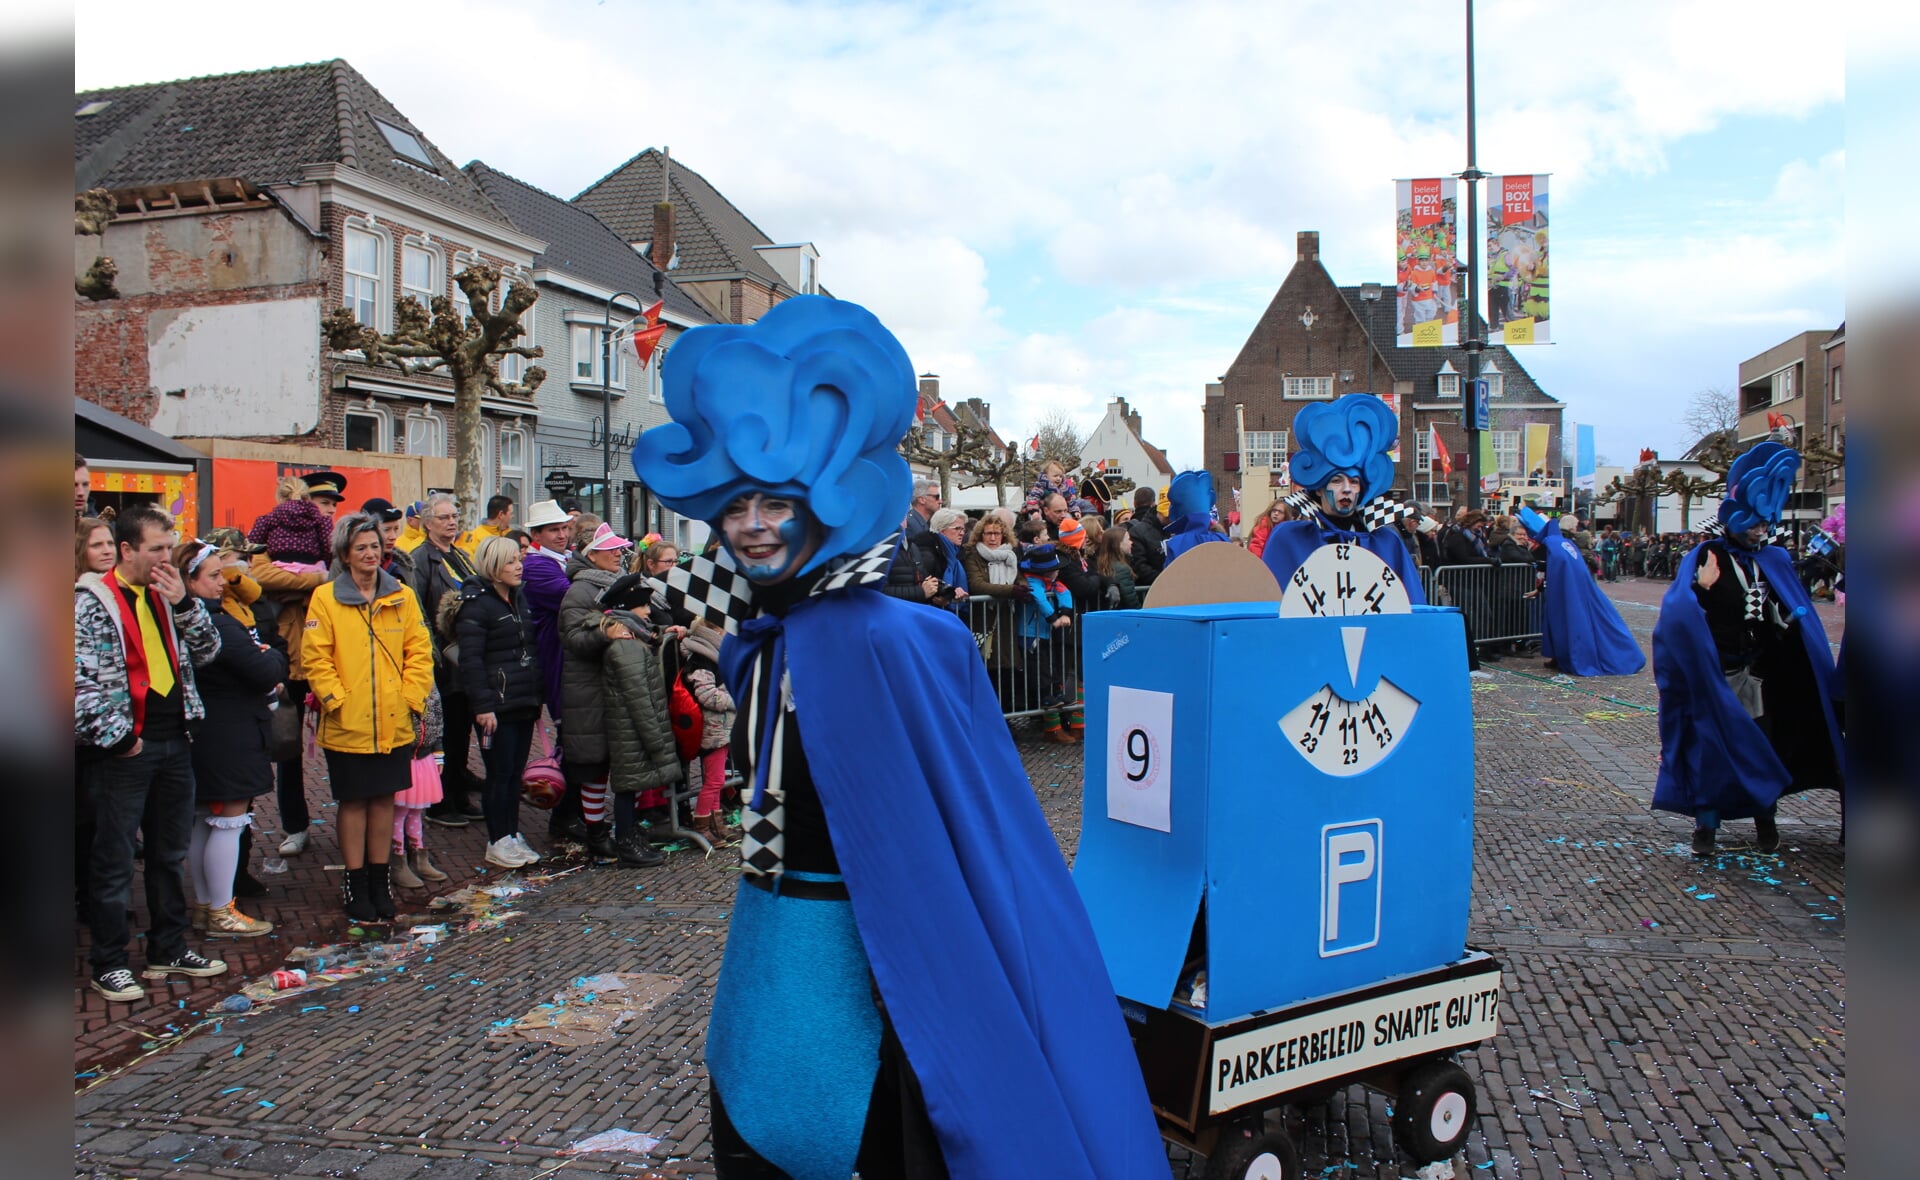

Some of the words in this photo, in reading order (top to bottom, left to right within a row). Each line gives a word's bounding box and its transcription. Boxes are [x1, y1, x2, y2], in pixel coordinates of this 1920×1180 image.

[1414, 185, 1439, 193] beleef
[1505, 181, 1530, 190] beleef
[1505, 191, 1530, 201] BOX
[1414, 194, 1439, 205] BOX
[1505, 202, 1531, 213] TEL
[1414, 205, 1440, 216] TEL
[1479, 382, 1487, 408] P
[1336, 545, 1350, 560] 23
[1293, 566, 1309, 587] 23
[1337, 571, 1356, 599] 11
[1381, 566, 1396, 587] 23
[1302, 583, 1326, 615] 11
[1364, 582, 1385, 613] 11
[1311, 702, 1331, 736] 11
[1361, 703, 1386, 735] 11
[1339, 716, 1358, 746] 11
[1376, 727, 1393, 749] 23
[1299, 732, 1319, 753] 23
[1127, 728, 1150, 782] 9
[1343, 748, 1359, 764] 23
[1326, 831, 1375, 941] P
[1218, 1020, 1365, 1092] PARKEERBELEID
[1373, 1001, 1441, 1046] SNAPTE
